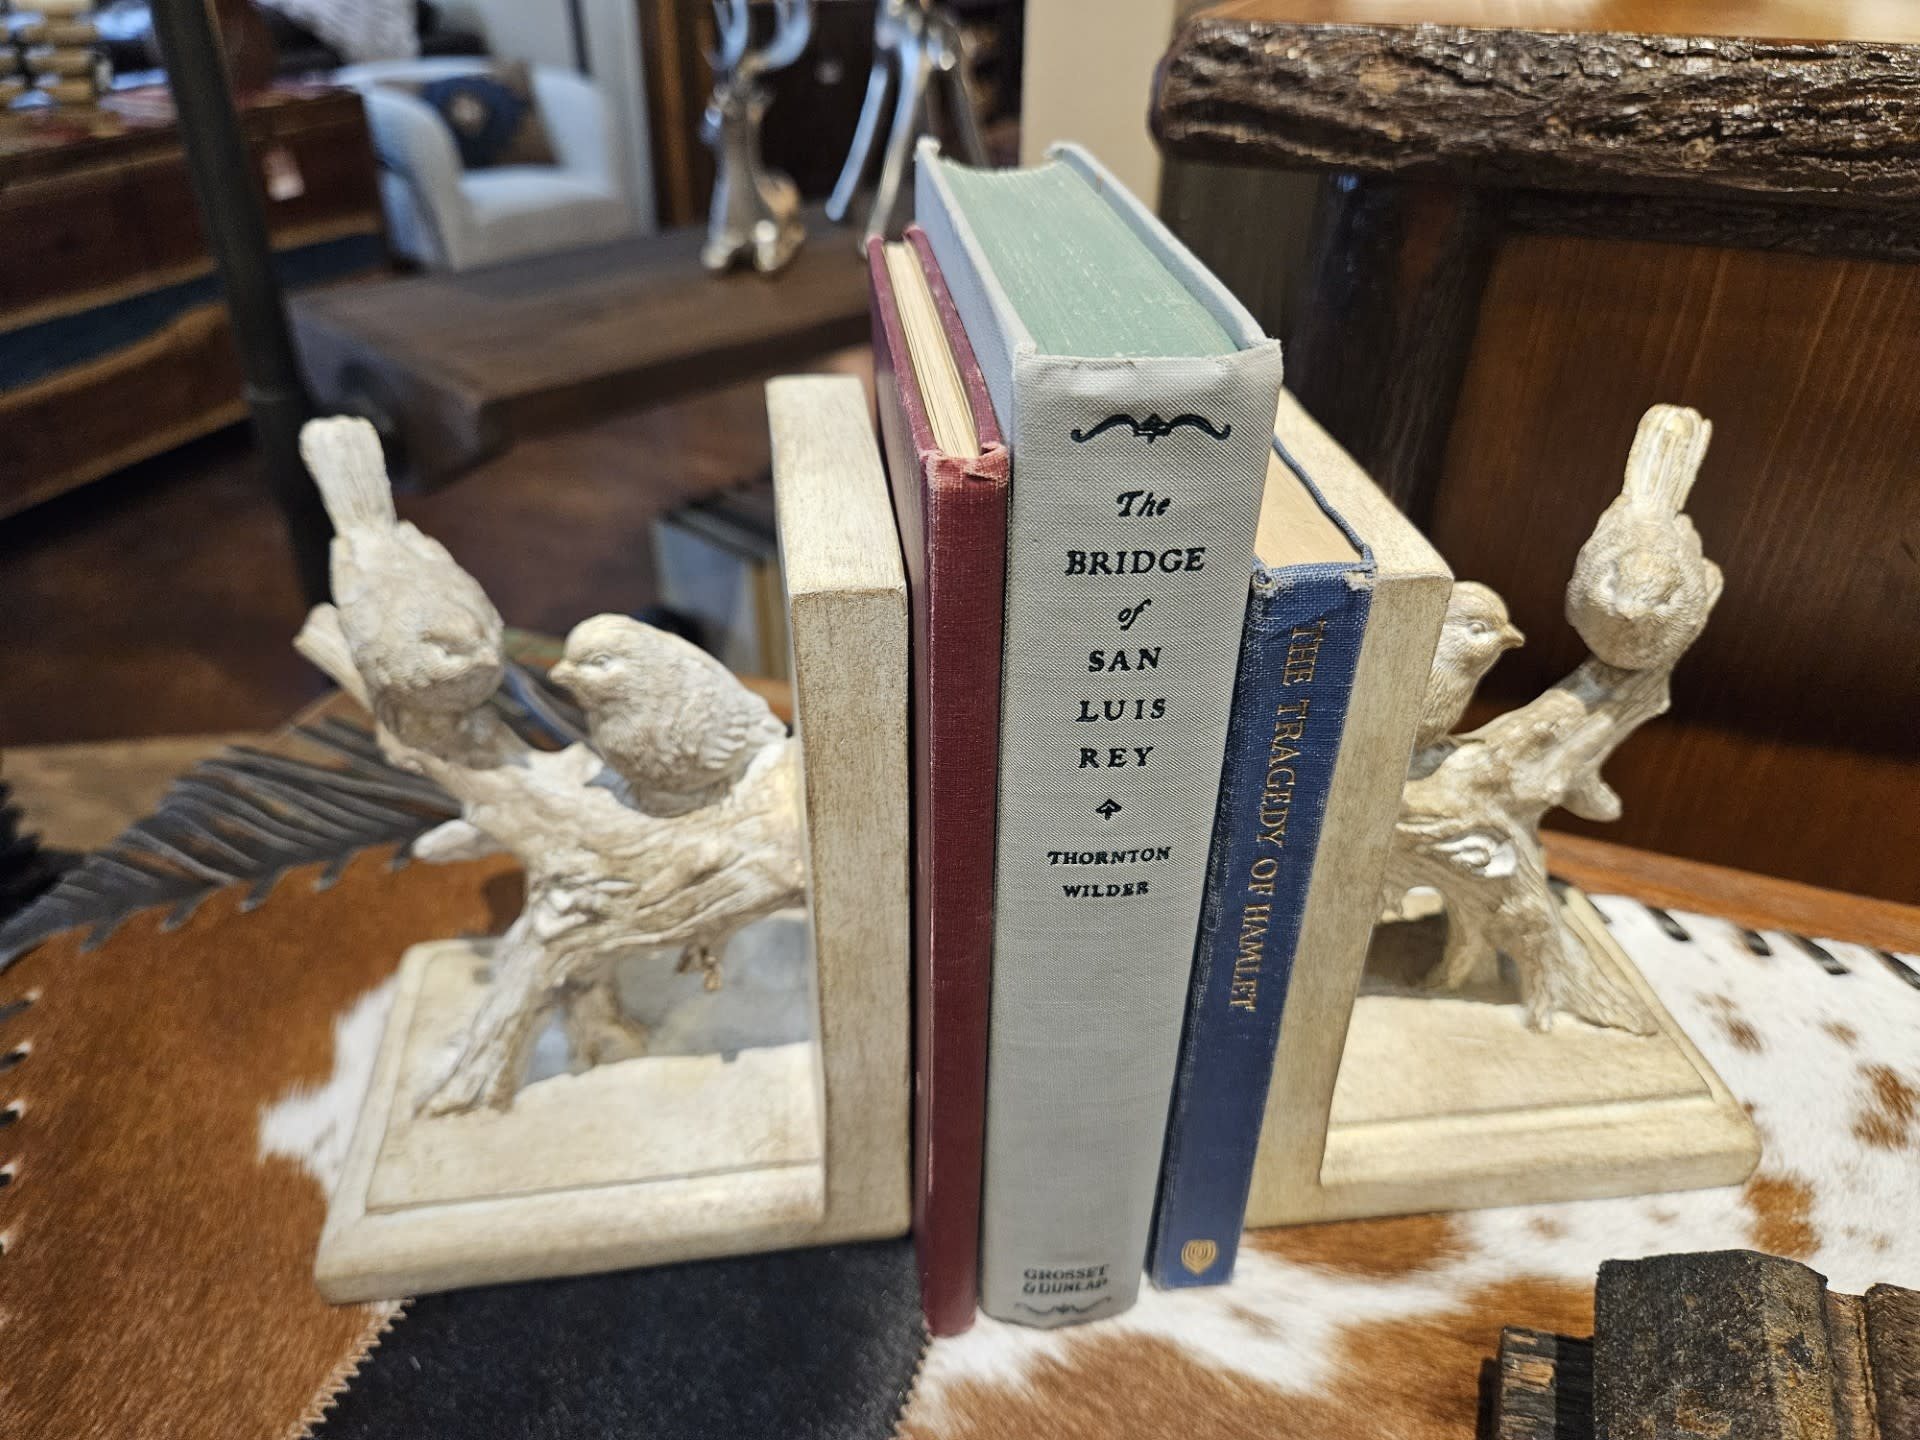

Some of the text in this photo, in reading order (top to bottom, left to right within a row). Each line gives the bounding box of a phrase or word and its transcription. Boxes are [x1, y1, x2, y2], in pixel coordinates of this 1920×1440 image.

[1116, 490, 1171, 518] The
[1065, 547, 1206, 576] BRIDGE
[1118, 599, 1152, 631] of
[1088, 647, 1162, 672] SAN
[1075, 698, 1166, 723] LUIS
[1078, 746, 1154, 769] REY
[1230, 618, 1328, 1012] THE TRAGEDY OF HAMLET
[1047, 846, 1172, 866] THORNTON
[1062, 881, 1149, 898] WILDER
[1023, 1263, 1109, 1280] GROSSET
[1038, 1278, 1108, 1295] DUNLAP
